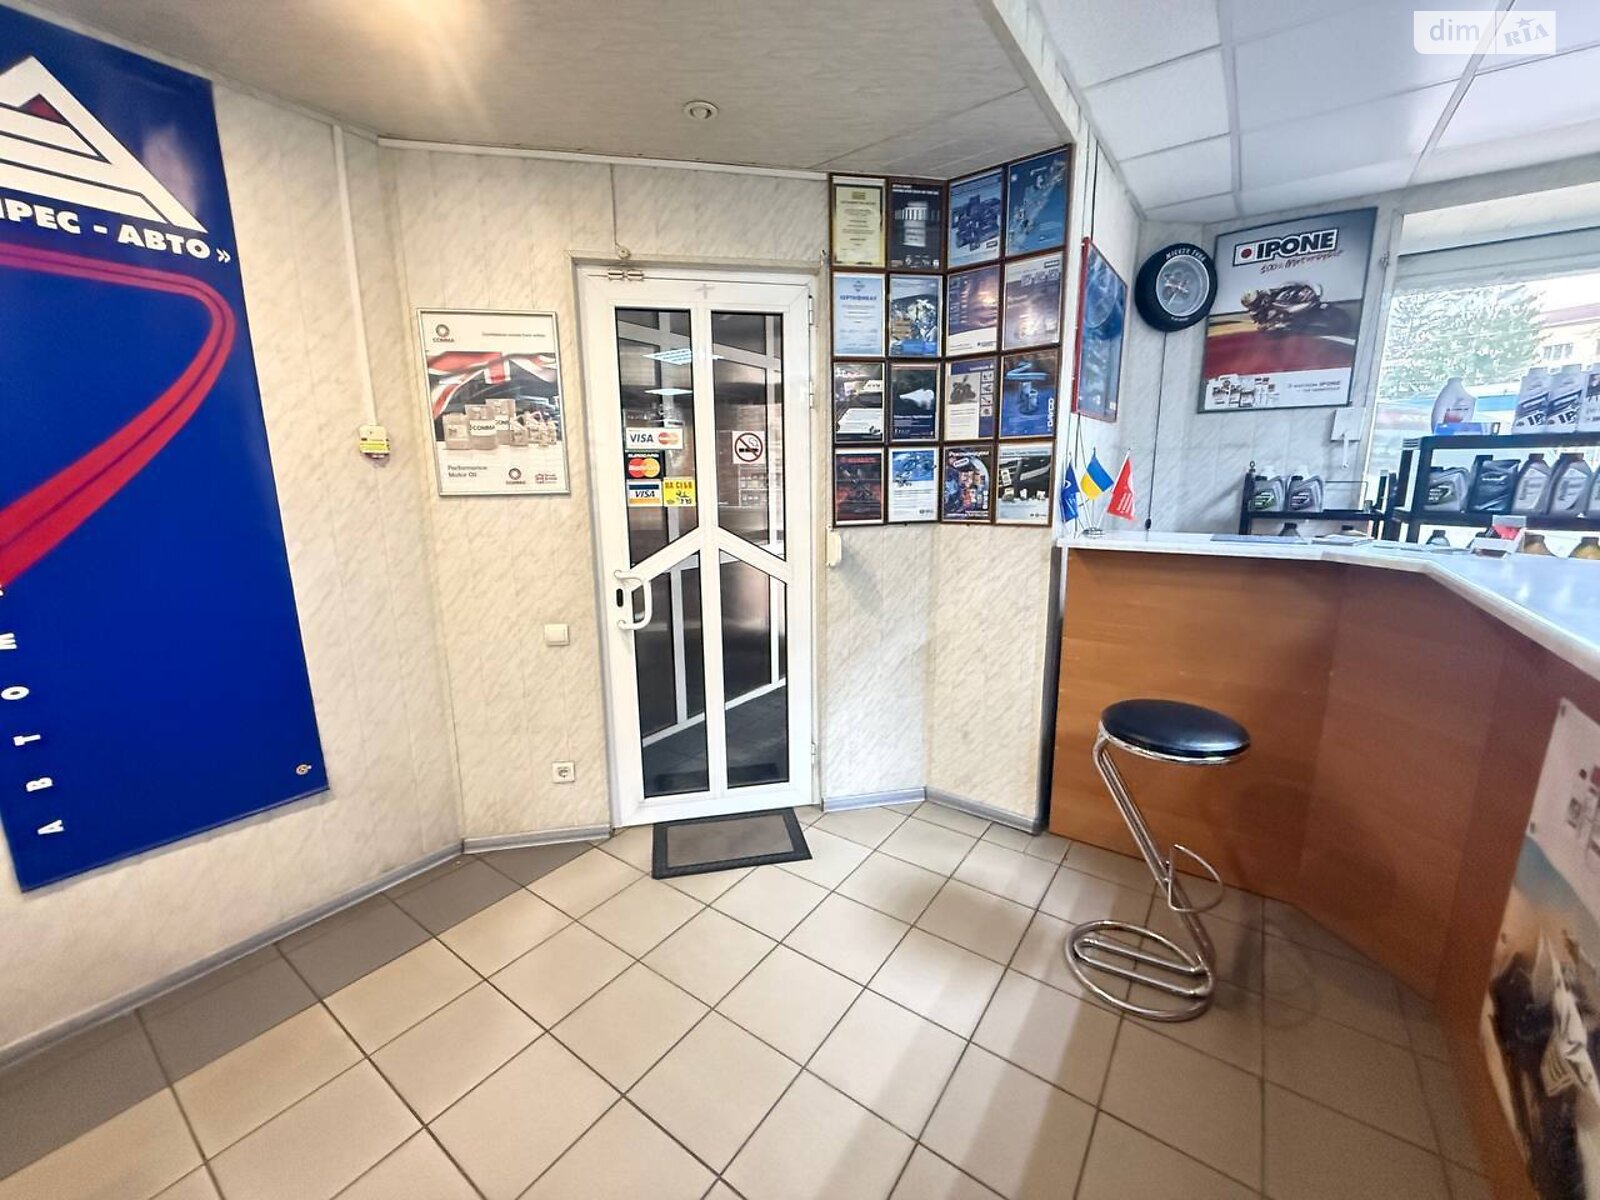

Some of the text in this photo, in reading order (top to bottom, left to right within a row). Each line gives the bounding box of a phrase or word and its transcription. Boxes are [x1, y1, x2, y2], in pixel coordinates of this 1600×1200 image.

[0, 198, 81, 235] РЕС
[117, 224, 211, 259] АВТО
[1256, 230, 1334, 260] IPONE
[630, 434, 654, 443] VISA
